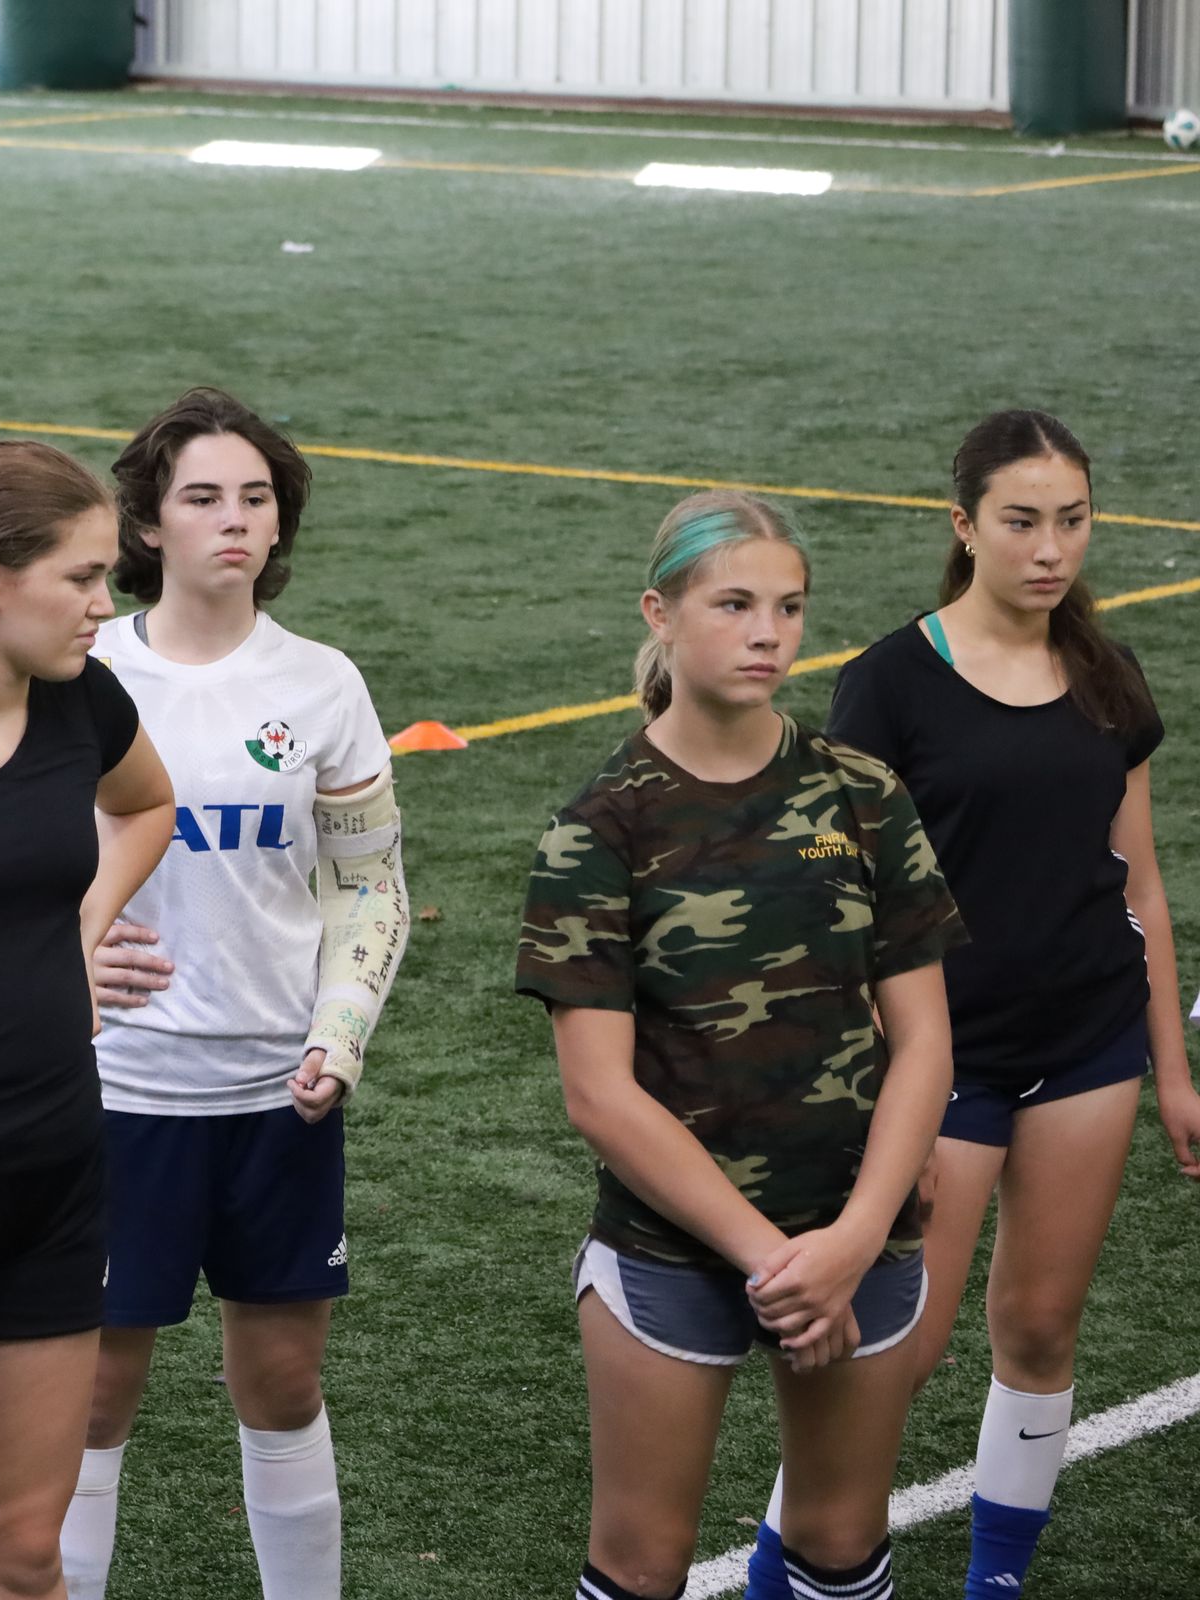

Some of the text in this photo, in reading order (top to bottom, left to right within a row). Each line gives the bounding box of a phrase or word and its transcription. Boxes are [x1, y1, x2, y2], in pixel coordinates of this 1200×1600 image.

[284, 748, 304, 769] TIROL
[815, 832, 849, 847] FNRA
[798, 844, 842, 860] YOUTH
[332, 859, 369, 891] Lotta
[387, 920, 401, 948] WAS
